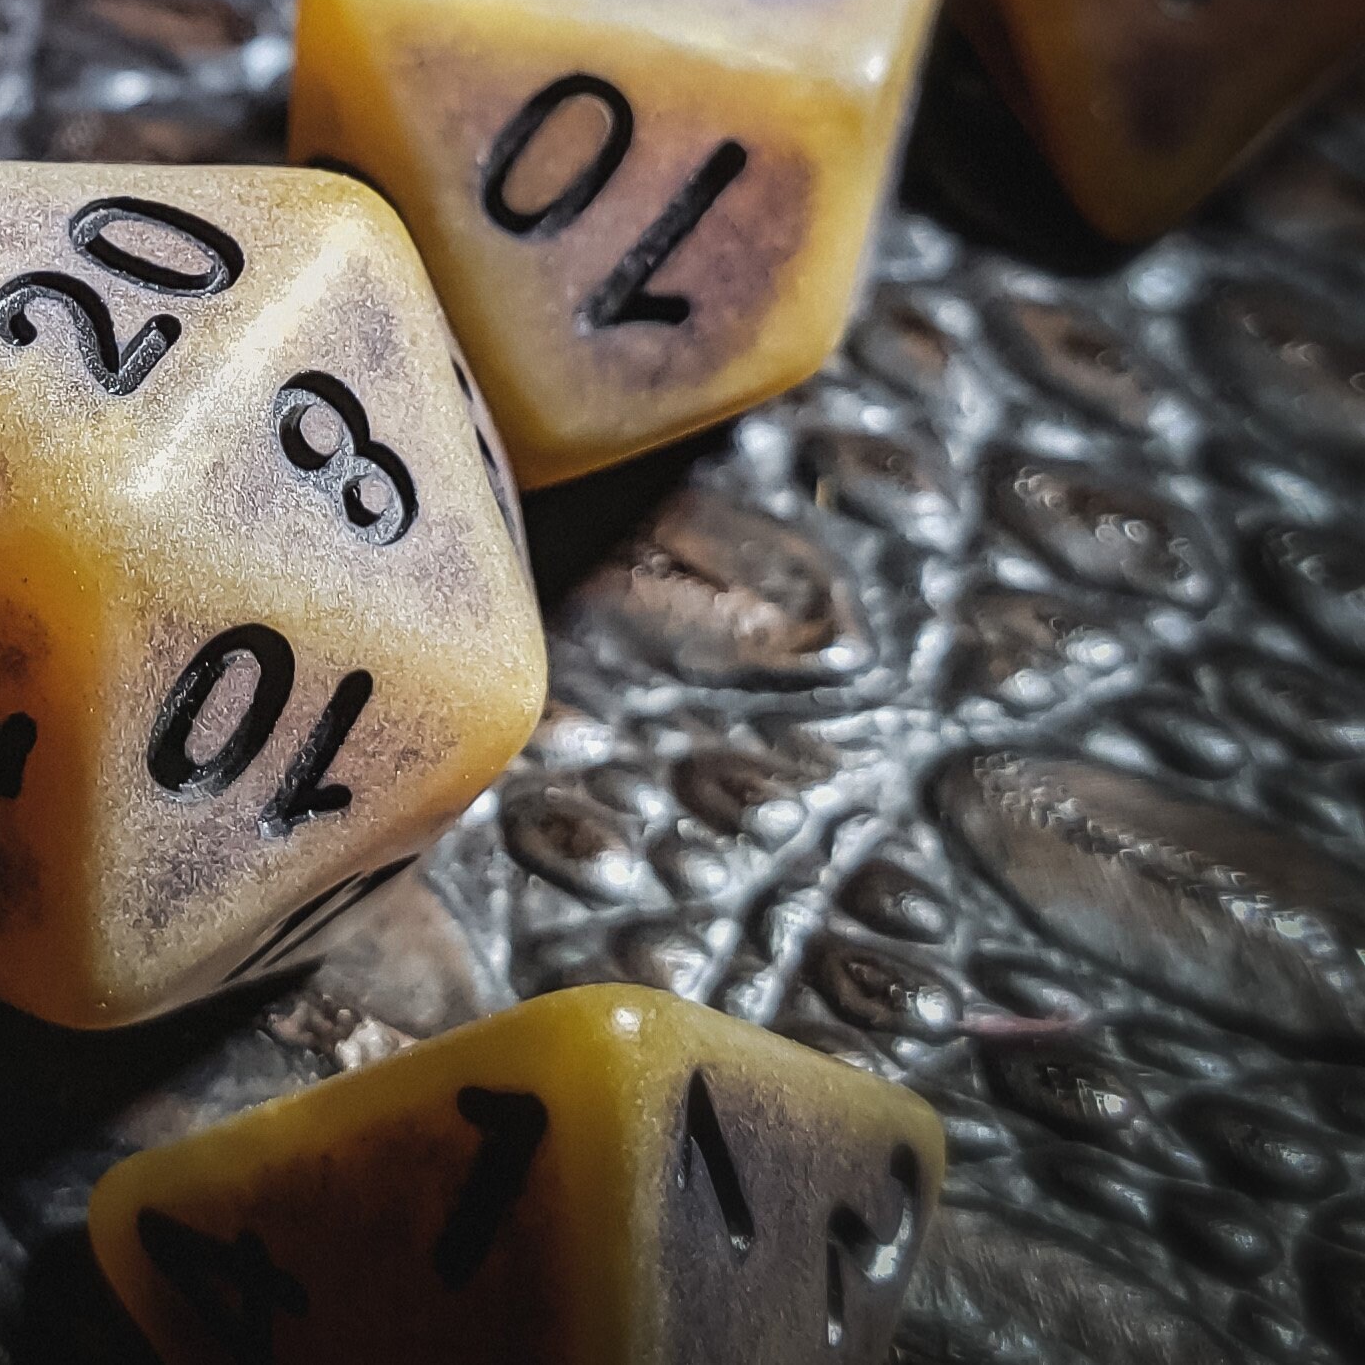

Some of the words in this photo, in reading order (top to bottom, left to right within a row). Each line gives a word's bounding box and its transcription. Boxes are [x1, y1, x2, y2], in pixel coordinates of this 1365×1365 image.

[480, 72, 748, 331] 10
[272, 369, 421, 547] 8
[146, 622, 375, 838] 10
[432, 1085, 550, 1292] 1
